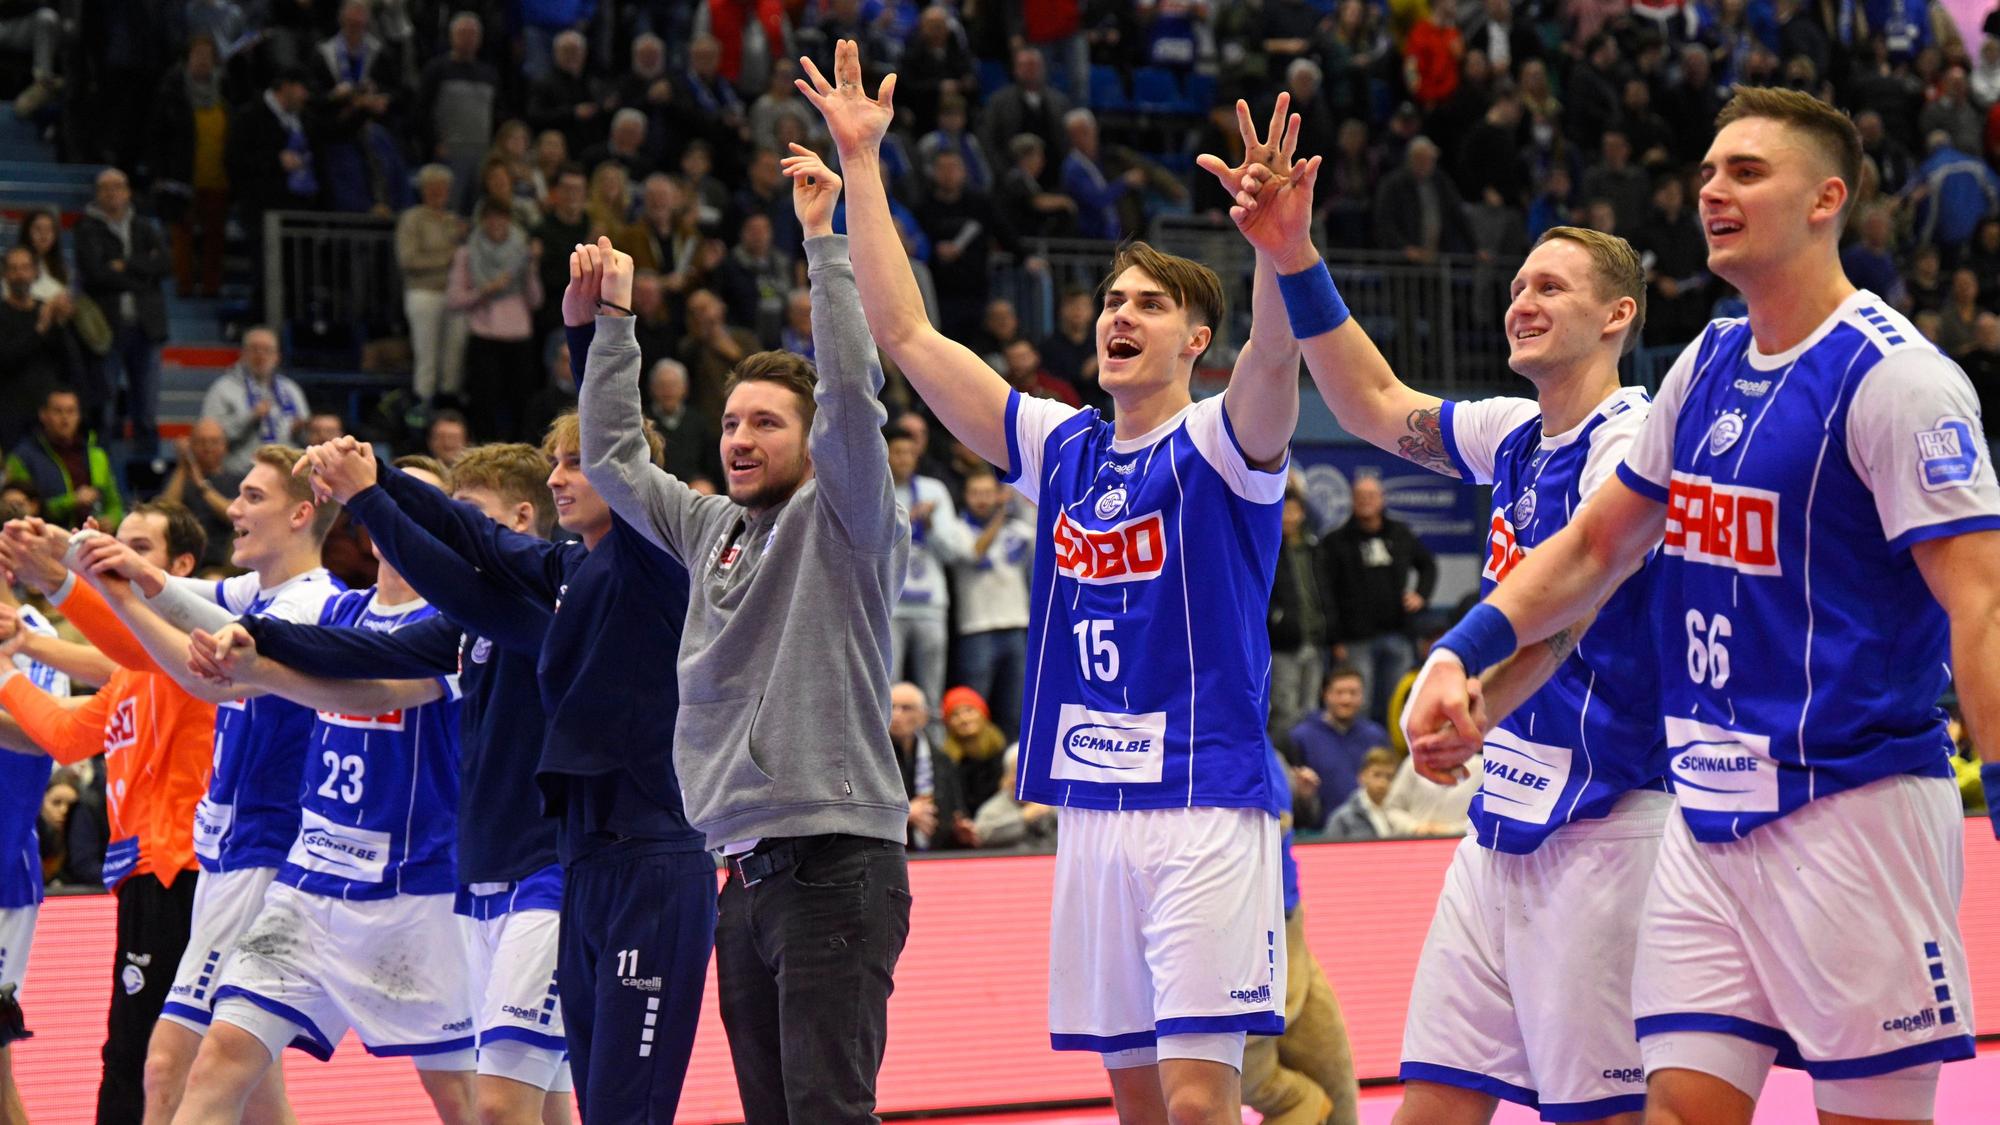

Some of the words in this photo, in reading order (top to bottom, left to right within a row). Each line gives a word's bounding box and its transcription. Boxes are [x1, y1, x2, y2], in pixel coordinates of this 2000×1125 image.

[1921, 431, 1959, 458] HK
[1663, 478, 1777, 567] SABO
[1054, 511, 1165, 579] SABO
[1073, 619, 1120, 682] 15
[1685, 608, 1733, 690] 66
[1071, 734, 1151, 753] SCHWALBE
[317, 750, 365, 804] 23
[1484, 758, 1551, 791] WALBE
[1677, 755, 1759, 772] SCHWALBE
[617, 949, 639, 977] 11
[621, 976, 662, 990] capelli
[1230, 984, 1271, 1002] capelli
[502, 1005, 538, 1019] capelli
[1883, 1008, 1935, 1031] capelli
